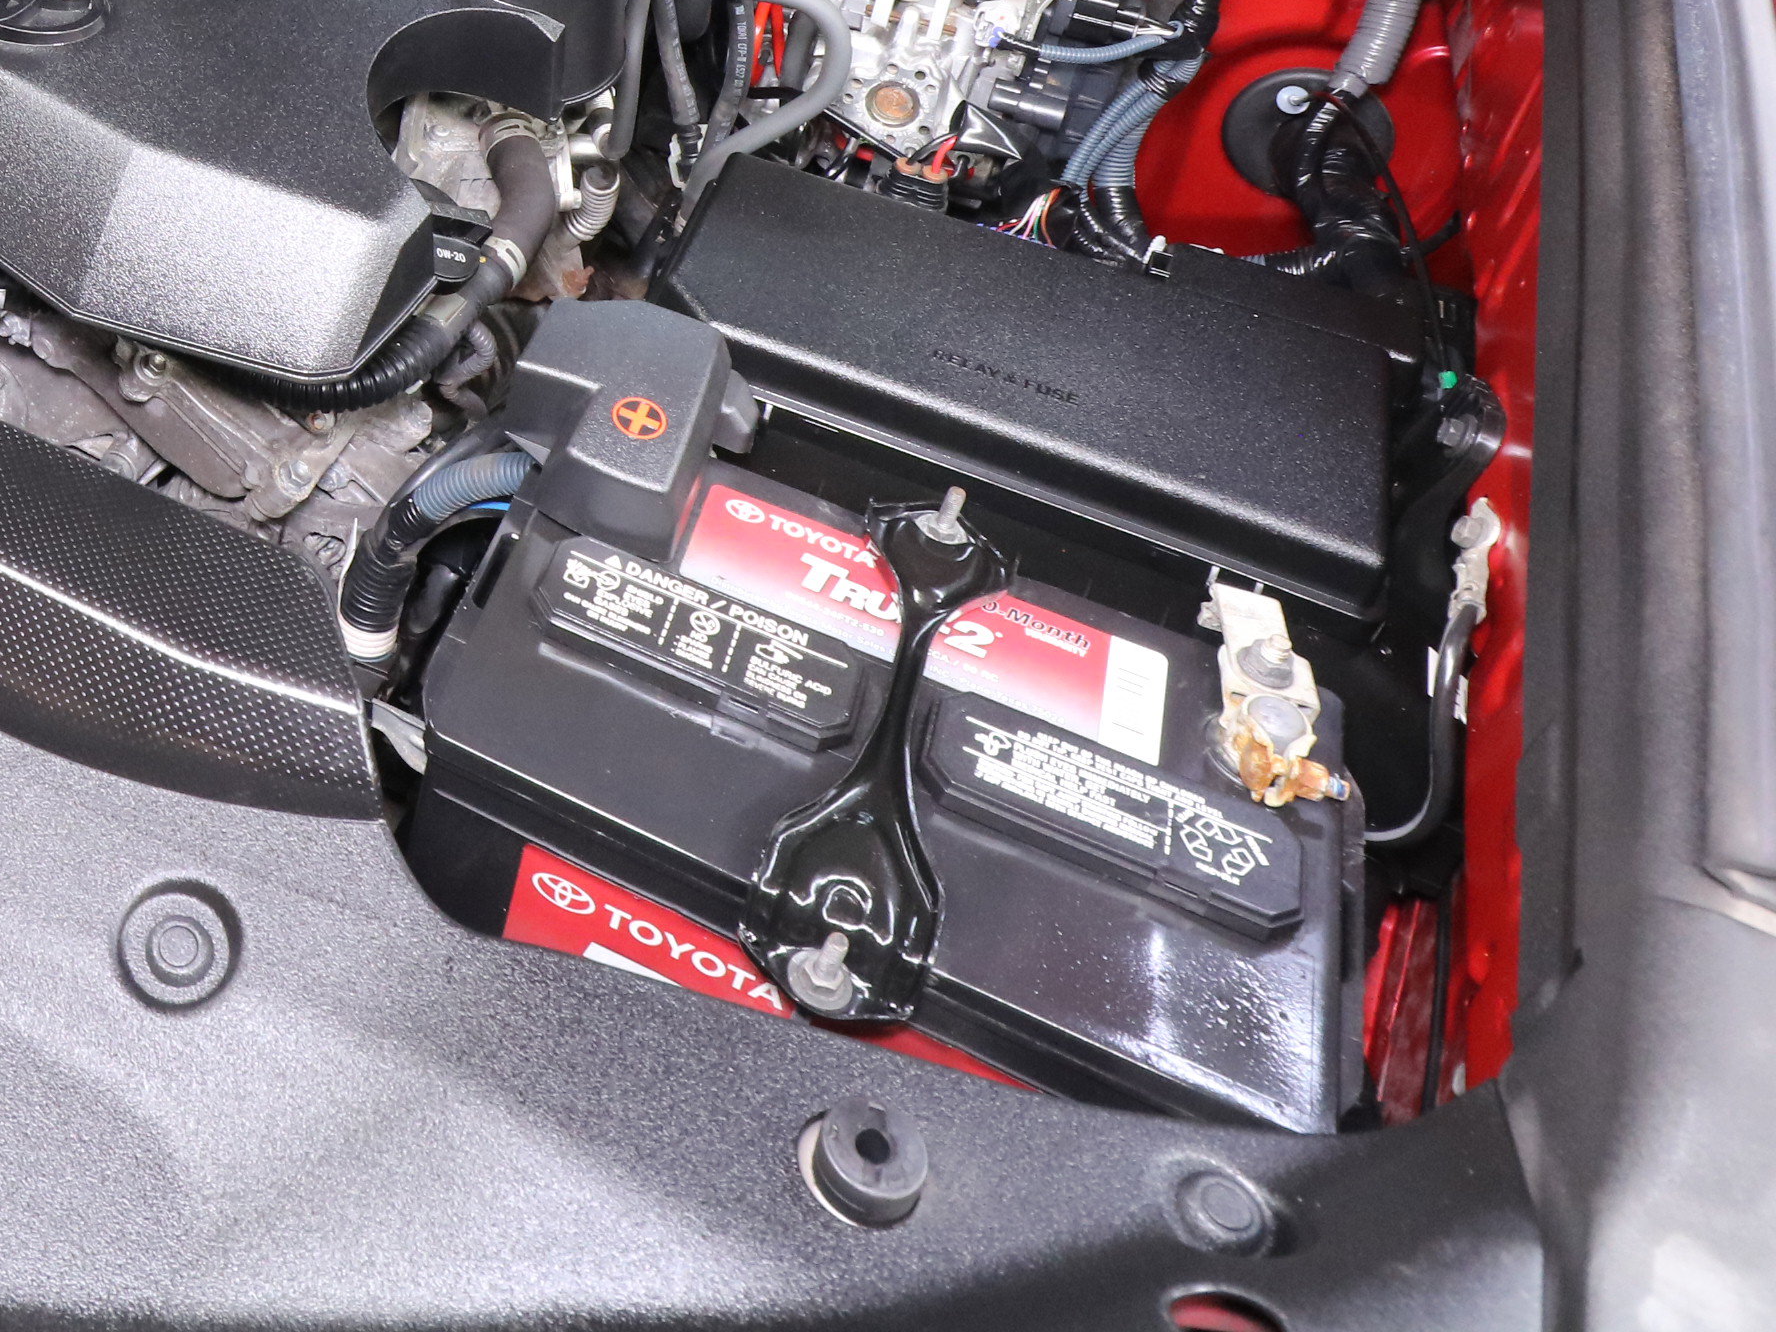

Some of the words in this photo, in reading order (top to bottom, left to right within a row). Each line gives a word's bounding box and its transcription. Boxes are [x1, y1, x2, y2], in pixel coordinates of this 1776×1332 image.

[436, 248, 467, 263] 0W-20
[1024, 379, 1080, 406] FUSE
[769, 514, 877, 568] TOYOTA
[624, 560, 709, 606] DANGER
[729, 604, 808, 647] POISON
[603, 904, 784, 1011] TOYOTA
